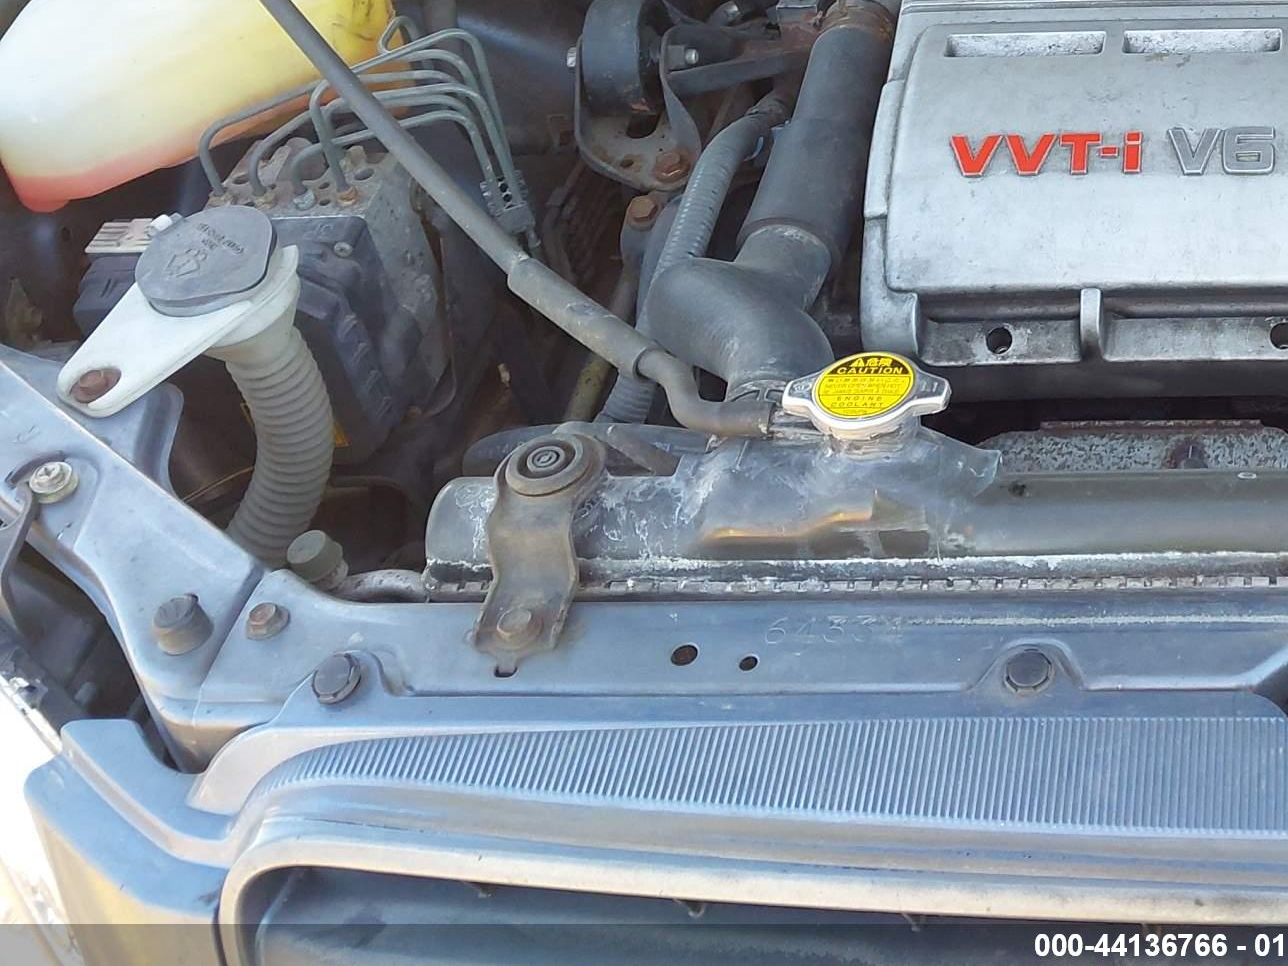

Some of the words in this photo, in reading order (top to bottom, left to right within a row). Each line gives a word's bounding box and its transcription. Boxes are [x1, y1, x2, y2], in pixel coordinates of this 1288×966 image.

[951, 130, 1144, 176] VVT-i
[1167, 126, 1276, 176] V6
[836, 366, 904, 375] CAUTION
